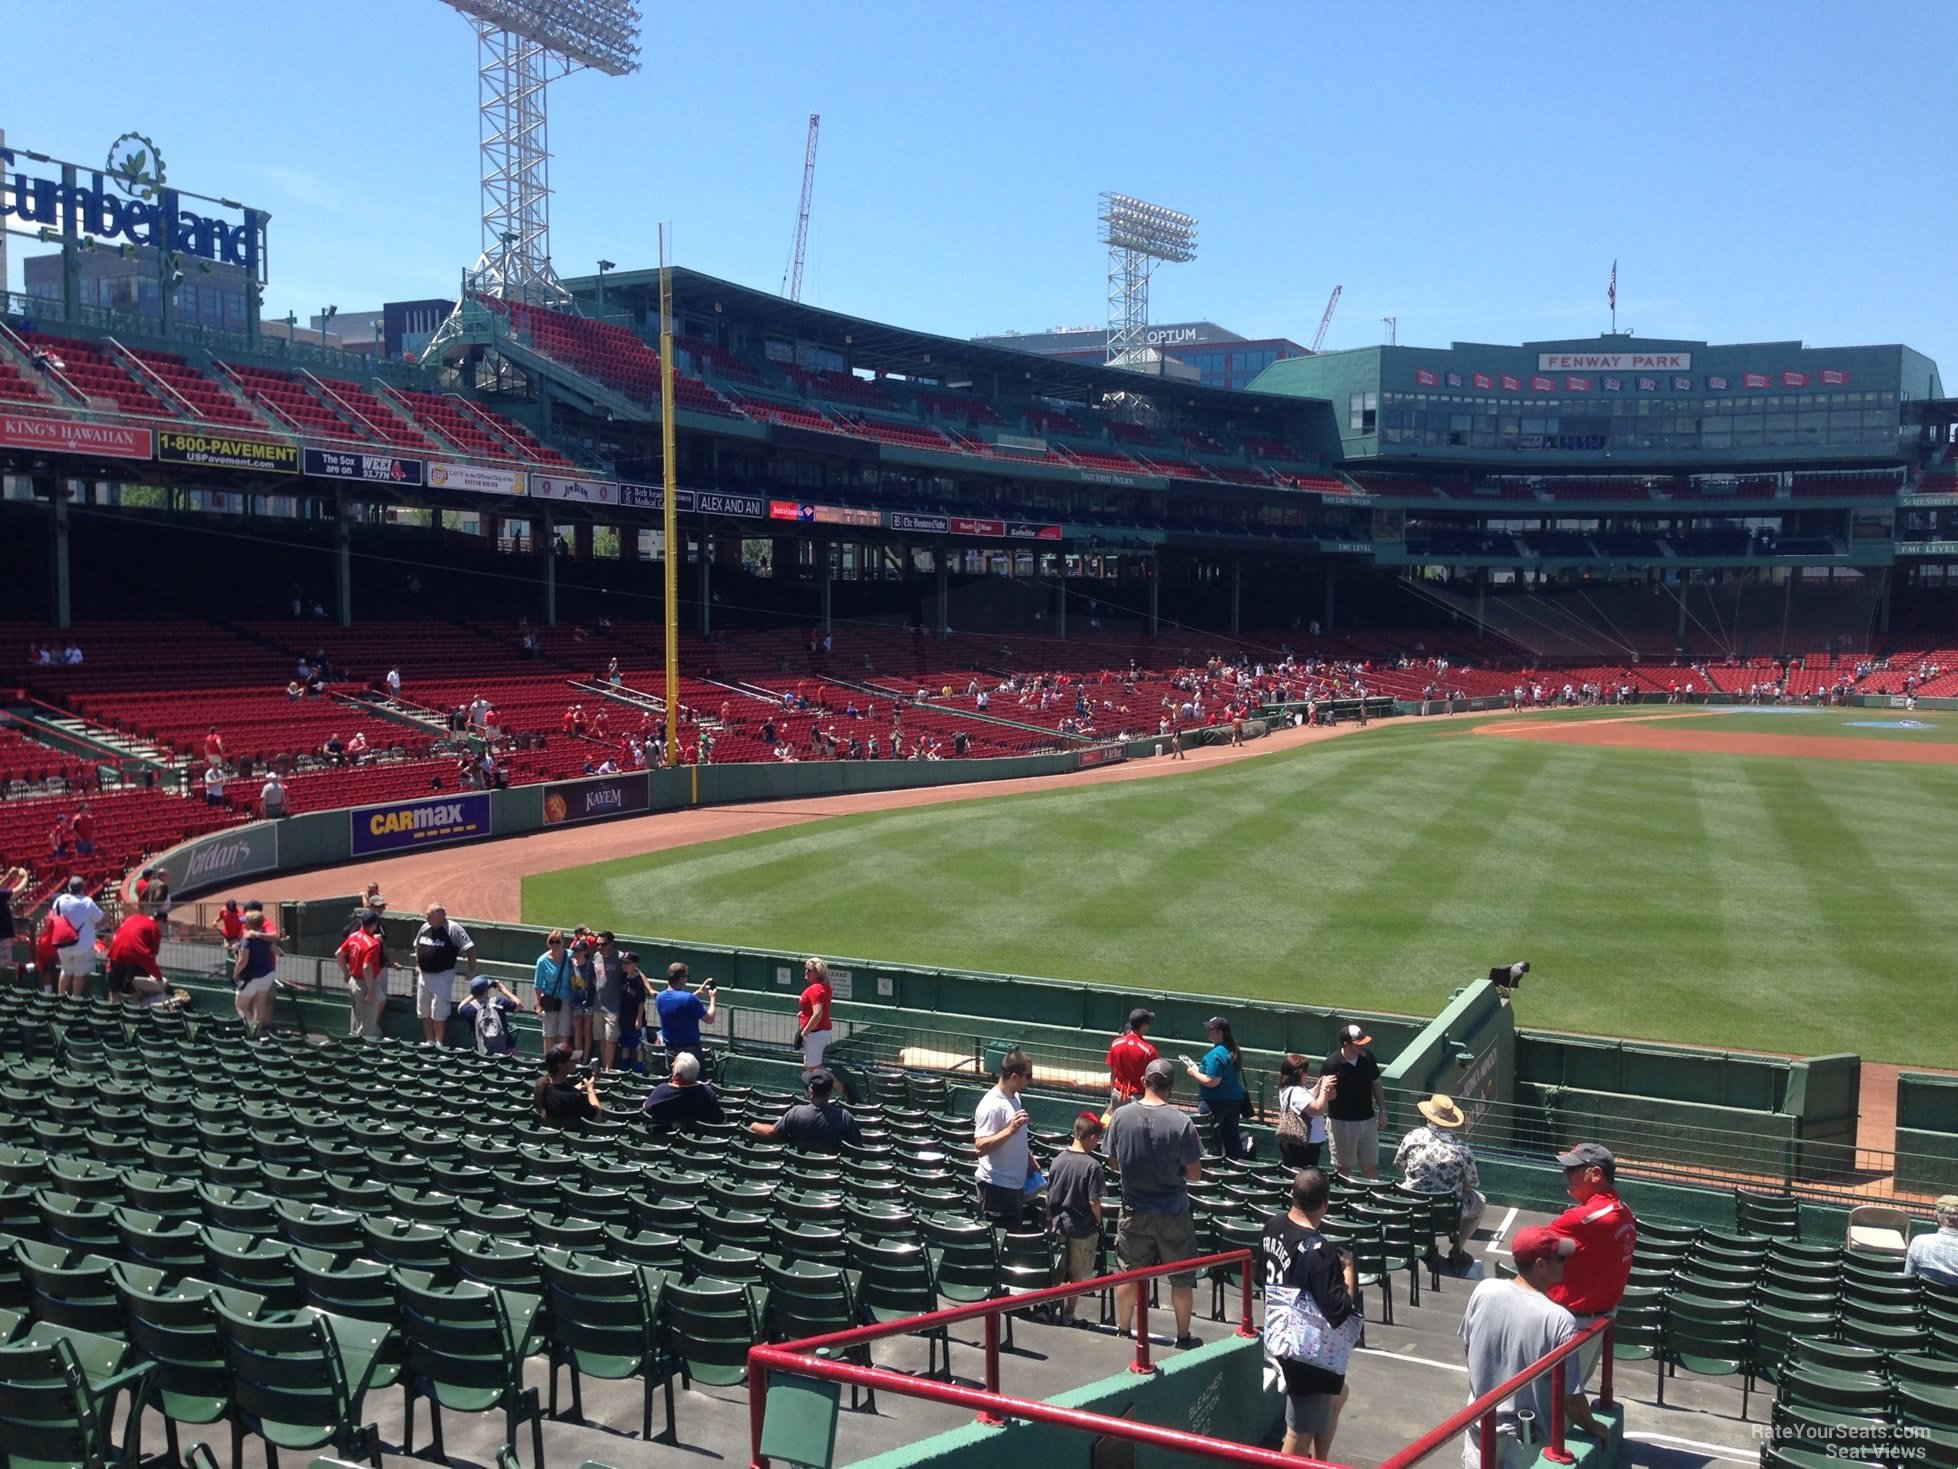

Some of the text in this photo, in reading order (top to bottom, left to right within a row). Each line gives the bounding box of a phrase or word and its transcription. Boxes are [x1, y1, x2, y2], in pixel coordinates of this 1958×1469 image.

[1147, 328, 1196, 343] OPTUM
[1549, 356, 1680, 368] FENWAY PARK
[6, 420, 135, 445] KING'S HAWAIIAN
[160, 434, 297, 462] 1-800-PAVEMENT
[186, 452, 275, 469] USPavement.com
[322, 454, 355, 466] The Sox
[362, 456, 393, 472] WEEI
[326, 465, 353, 475] are on
[634, 487, 647, 497] Beth
[635, 497, 656, 507] Medical
[700, 496, 760, 515] ALEX AND ANI
[903, 517, 913, 528] The
[914, 517, 932, 529] Boston
[1925, 545, 1956, 553] LEVEL
[585, 789, 621, 812] KAYEM
[180, 840, 250, 887] Jordan's
[1263, 1236, 1291, 1272] FRAZIER
